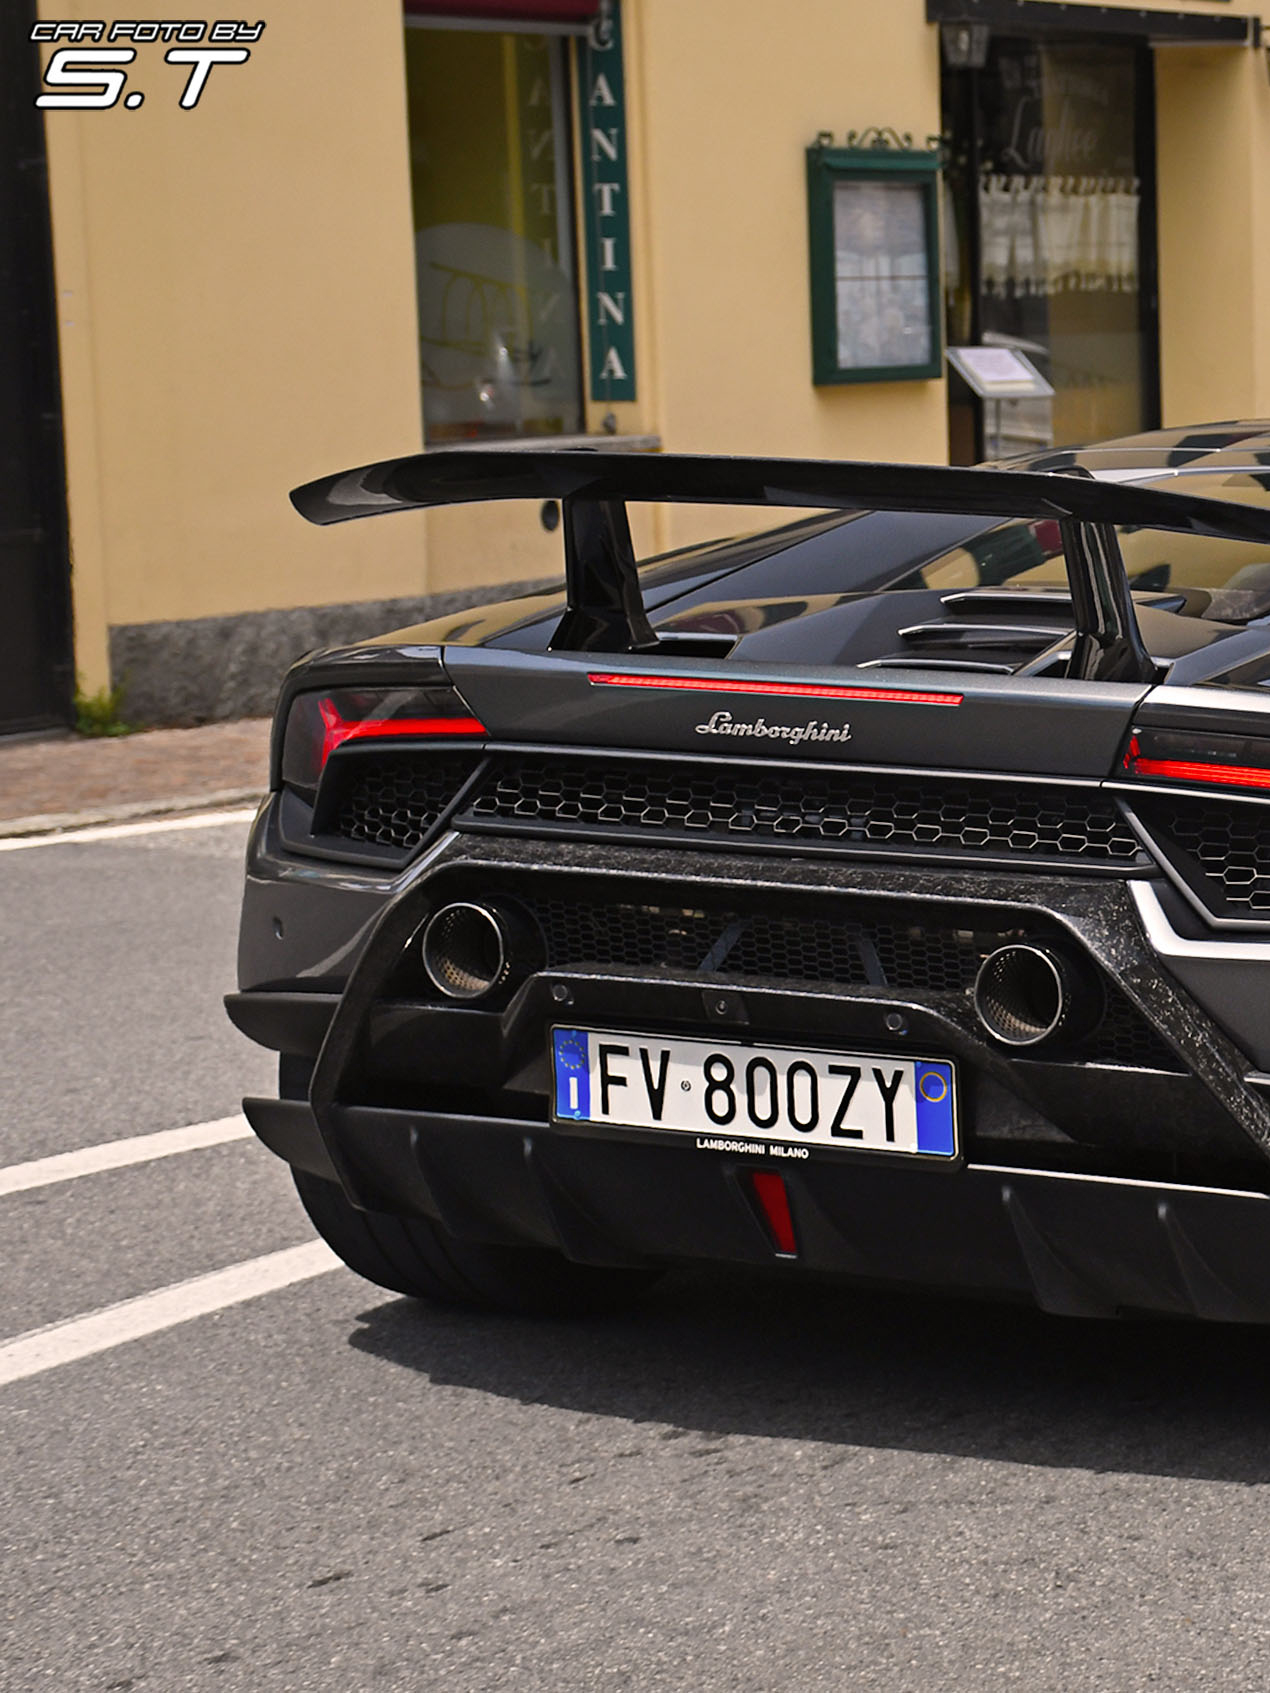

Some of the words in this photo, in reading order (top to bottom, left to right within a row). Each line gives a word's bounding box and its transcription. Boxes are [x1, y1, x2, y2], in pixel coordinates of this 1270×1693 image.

[588, 17, 627, 380] CANTINA
[695, 711, 852, 745] Lamborghini
[599, 1043, 671, 1121] FV
[703, 1053, 904, 1143] 800ZY
[696, 1138, 765, 1155] LAMBORGHINI
[769, 1145, 809, 1159] MILANO
